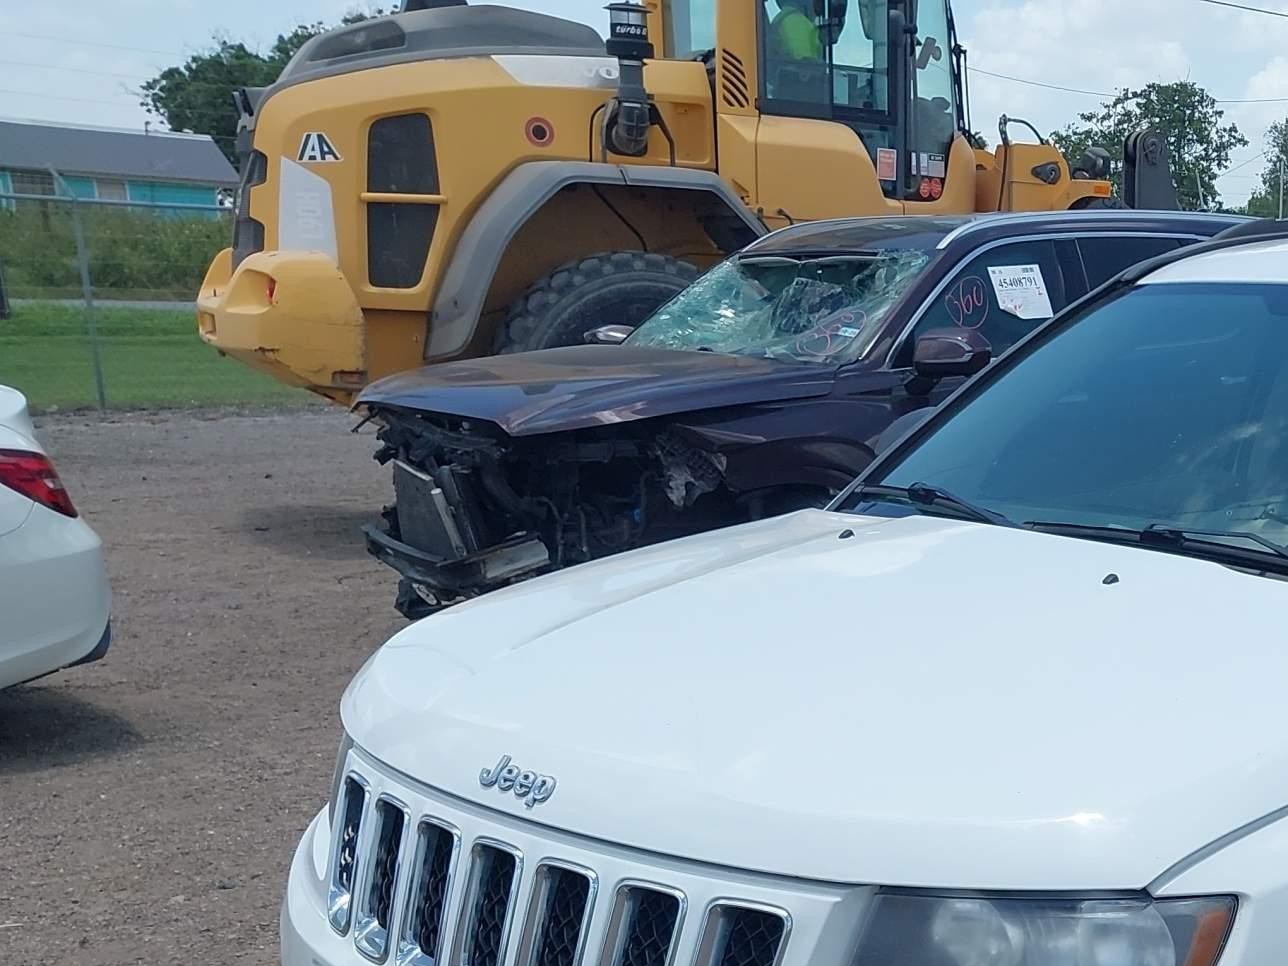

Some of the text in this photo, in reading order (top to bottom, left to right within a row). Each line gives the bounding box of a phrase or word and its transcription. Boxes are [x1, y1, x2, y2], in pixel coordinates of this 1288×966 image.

[615, 25, 641, 35] turbo
[998, 276, 1038, 289] 45408791
[479, 754, 557, 808] Jeep
